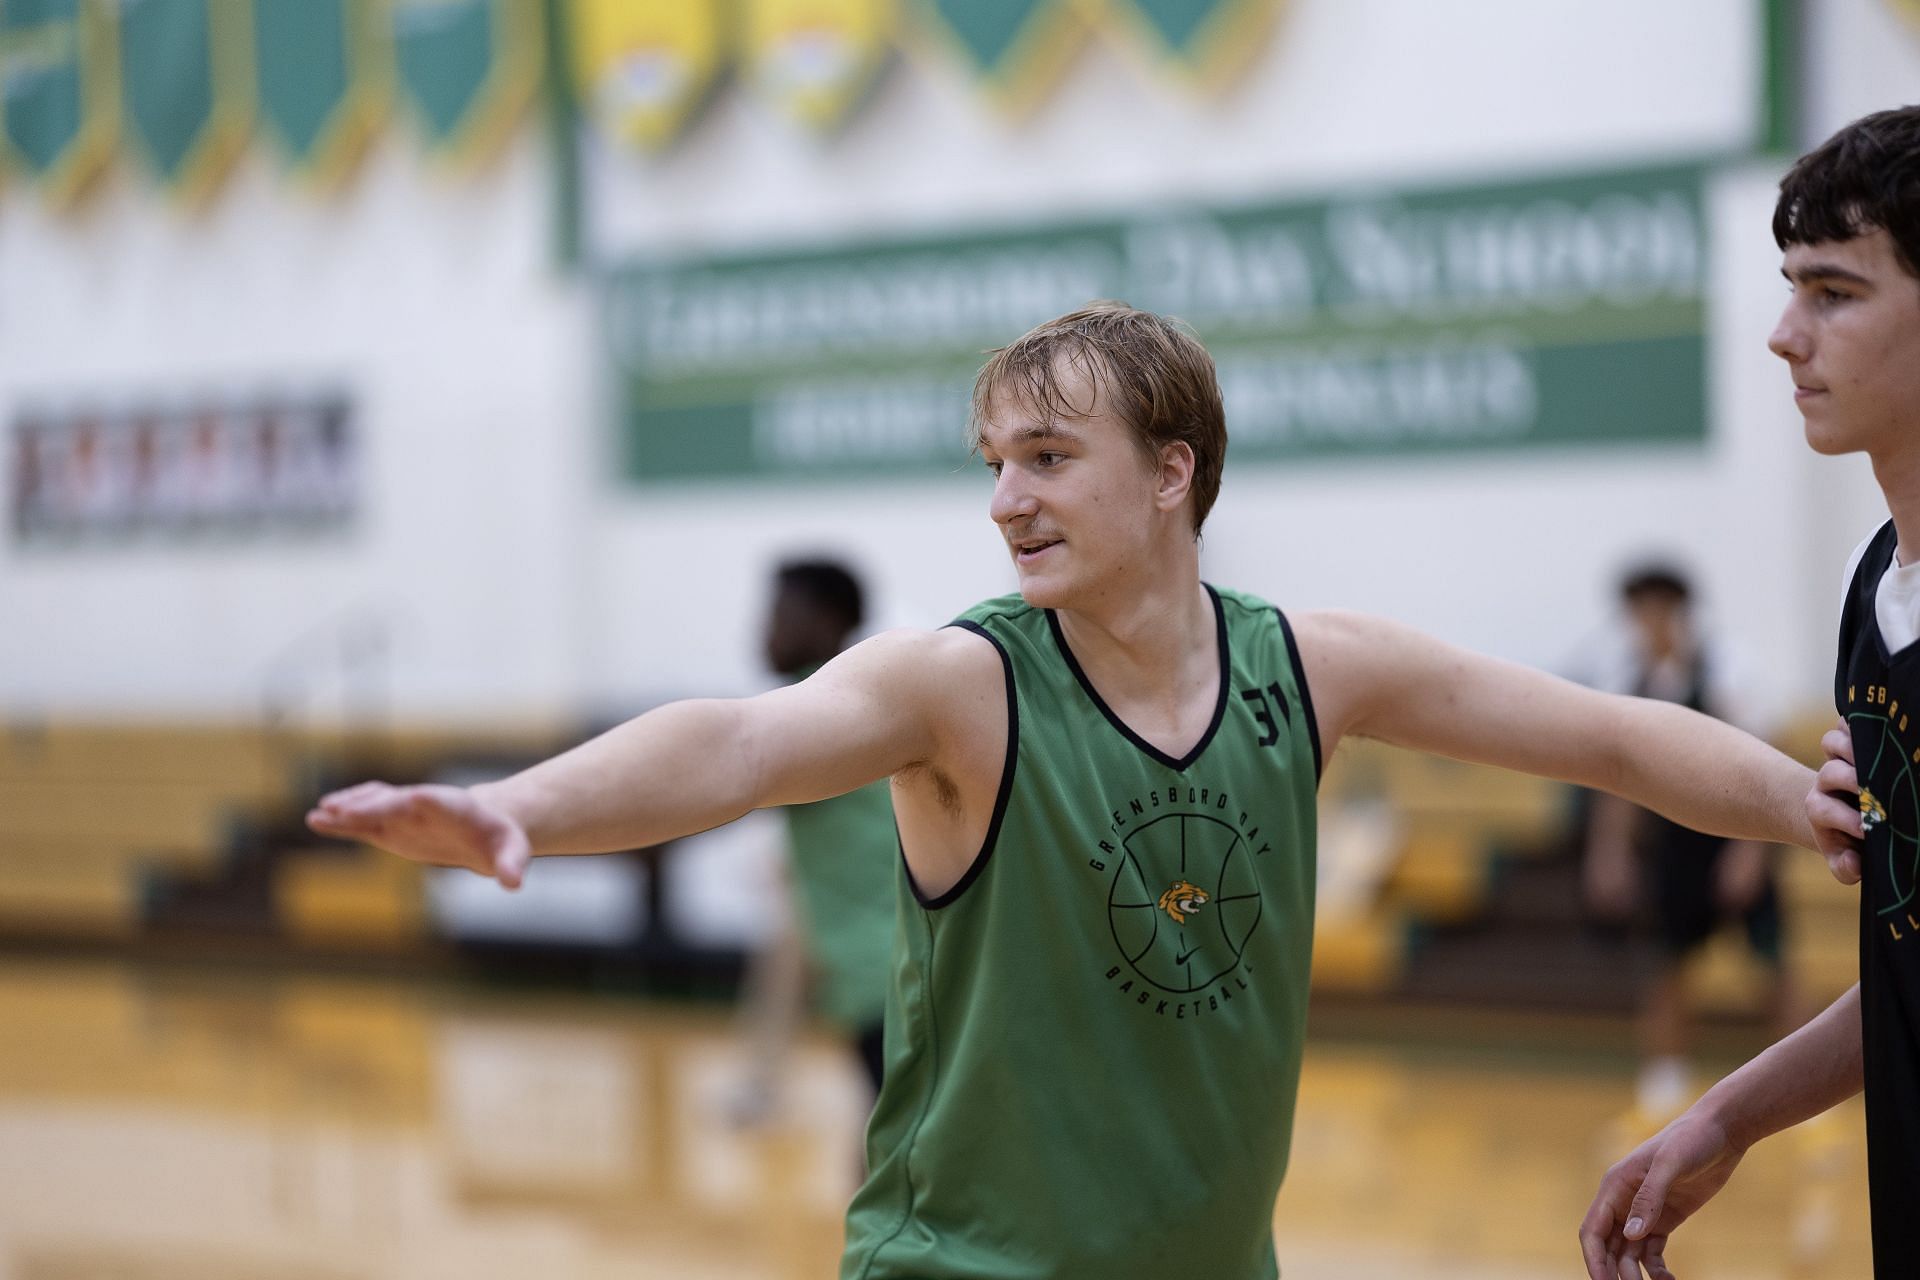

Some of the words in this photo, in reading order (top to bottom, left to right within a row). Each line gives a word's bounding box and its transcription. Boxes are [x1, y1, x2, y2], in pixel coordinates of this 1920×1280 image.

[1240, 680, 1291, 748] 31
[1240, 812, 1271, 855] DAY
[1106, 964, 1253, 1018] BASKETBALL
